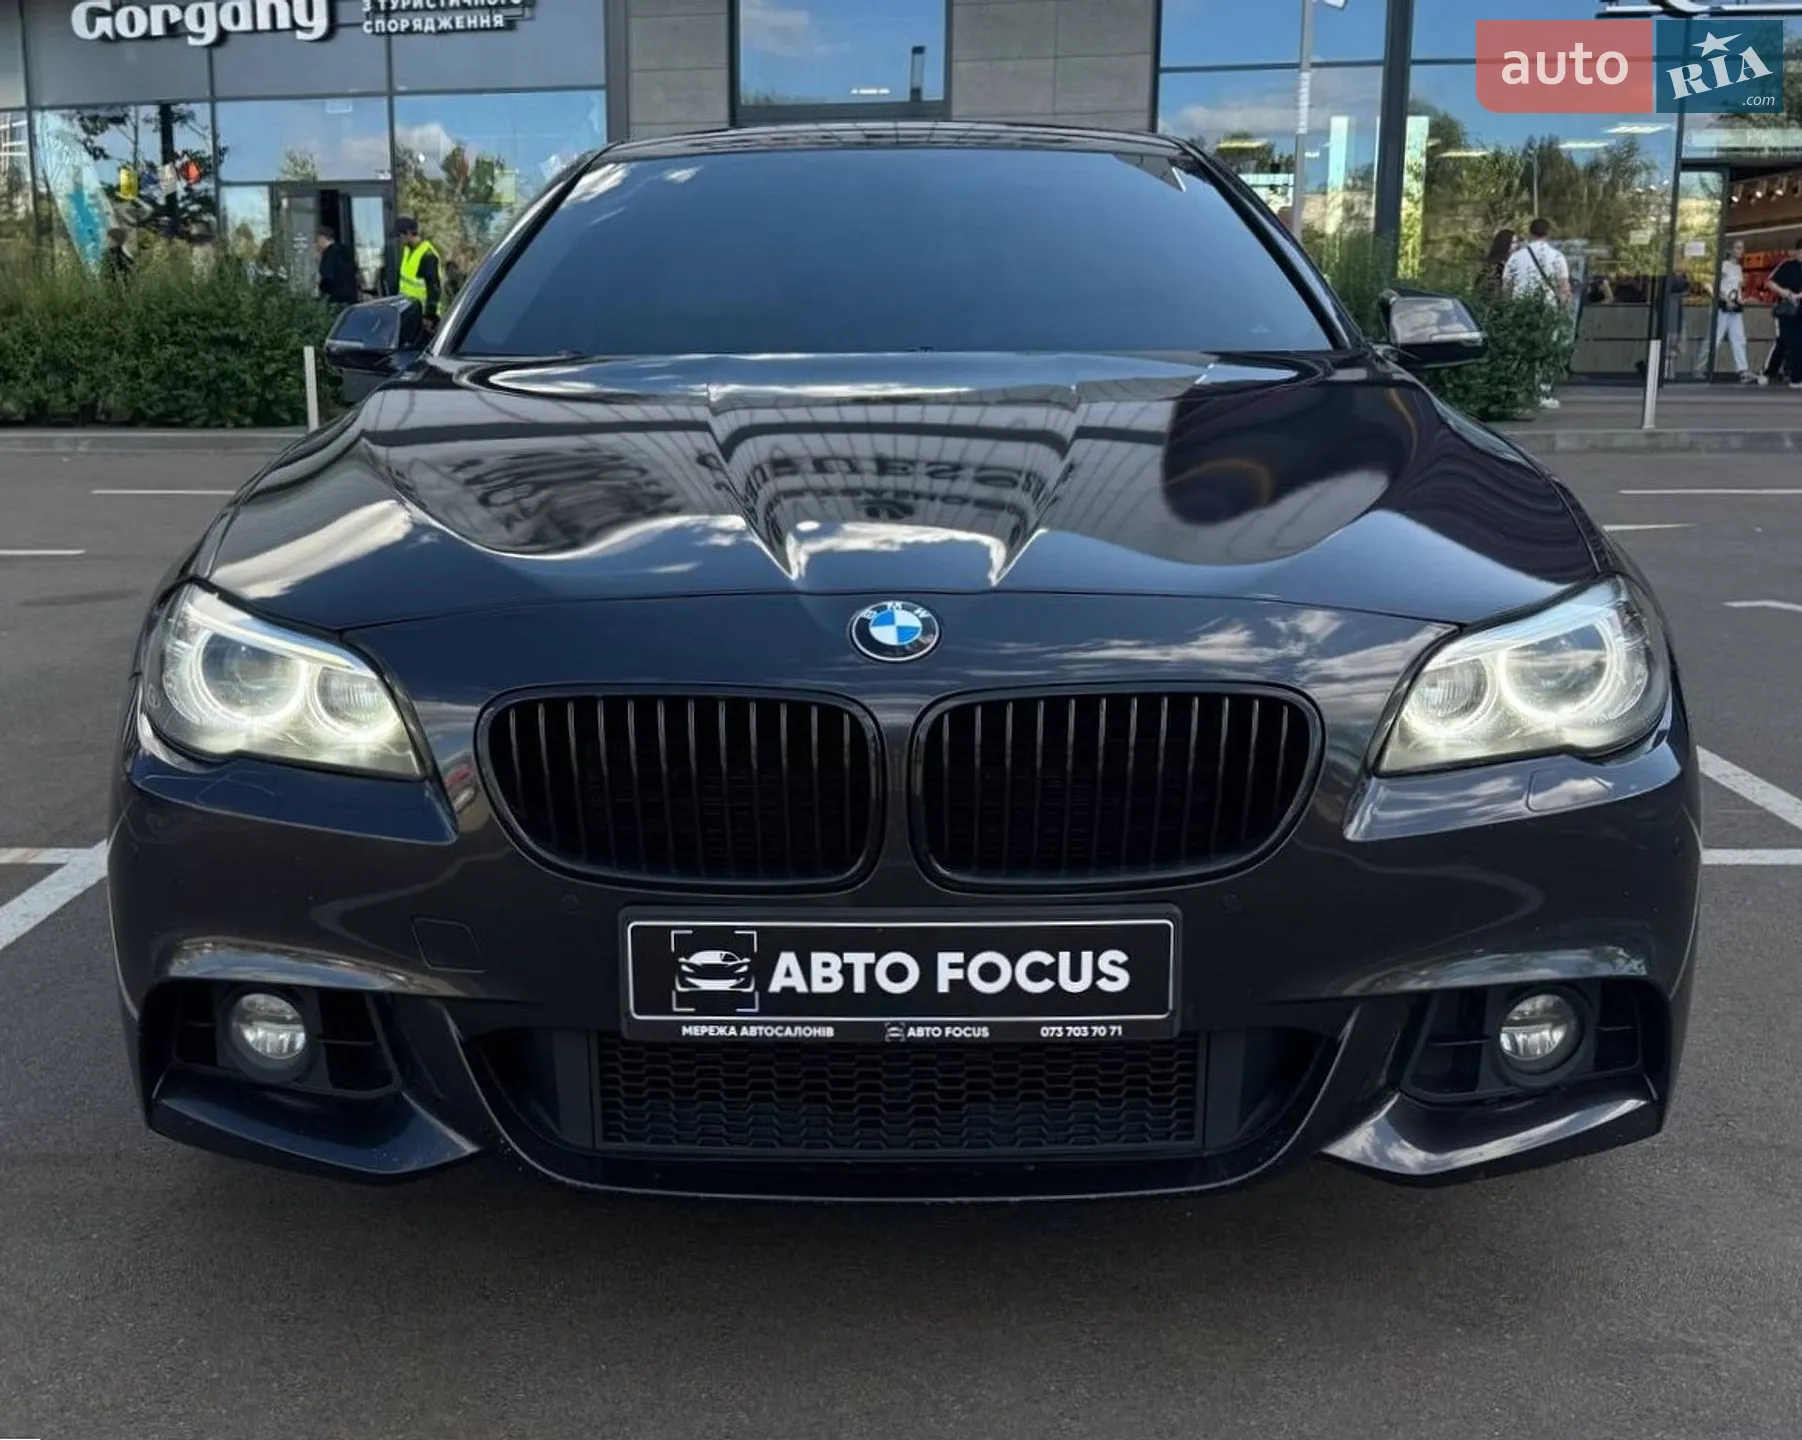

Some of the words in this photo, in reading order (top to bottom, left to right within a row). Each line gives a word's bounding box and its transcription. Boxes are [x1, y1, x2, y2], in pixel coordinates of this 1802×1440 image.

[71, 0, 328, 46] Gorgany
[362, 14, 504, 34] СПОРЯДЖЕННЯ
[768, 951, 920, 994] АВТО
[937, 949, 1131, 994] FOCUS
[682, 1025, 738, 1037] МЕРЕЖА
[740, 1025, 834, 1038] АВТОСАЛОНІВ
[907, 1026, 942, 1038] АВТО
[945, 1026, 989, 1038] FOCUS
[1040, 1026, 1063, 1038] 073
[1066, 1026, 1089, 1038] 703
[1091, 1025, 1107, 1037] 70
[1109, 1025, 1123, 1037] 71
